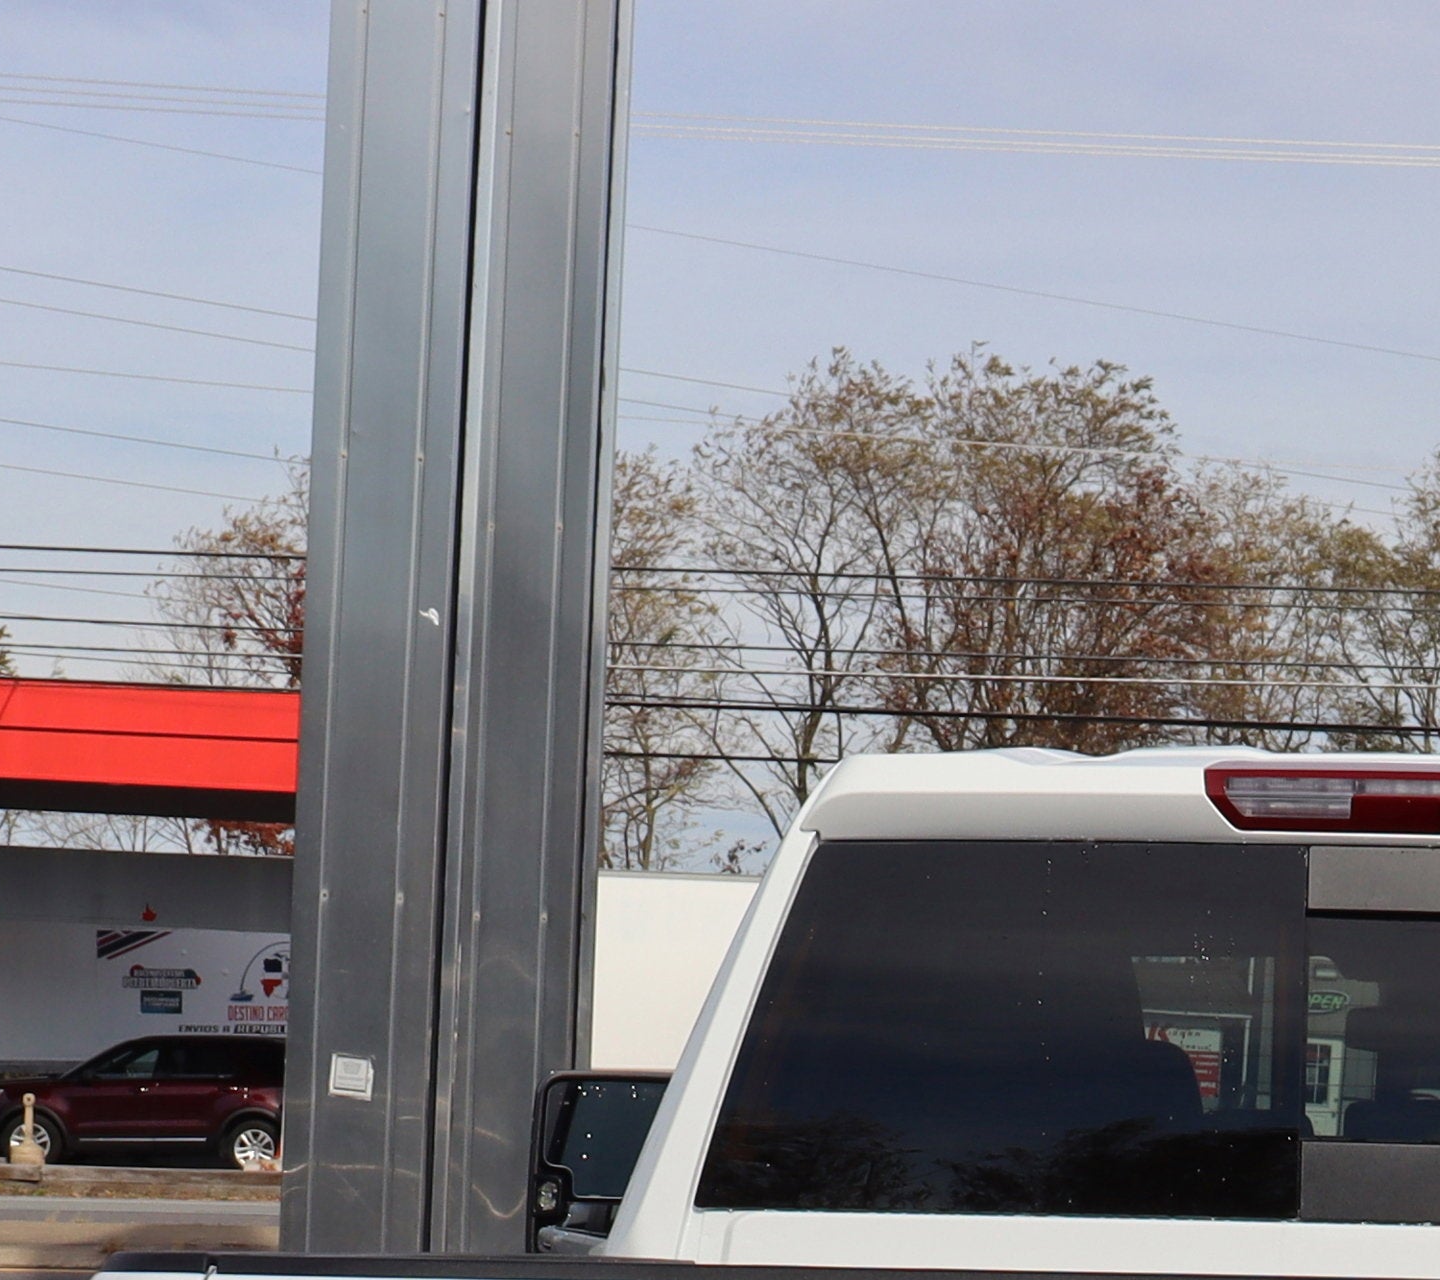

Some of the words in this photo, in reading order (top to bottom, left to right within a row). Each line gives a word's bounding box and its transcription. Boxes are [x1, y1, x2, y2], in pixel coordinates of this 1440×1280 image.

[1309, 993, 1345, 1010] PEN
[228, 1005, 264, 1021] DESTINO
[178, 1024, 219, 1033] ENVIOS
